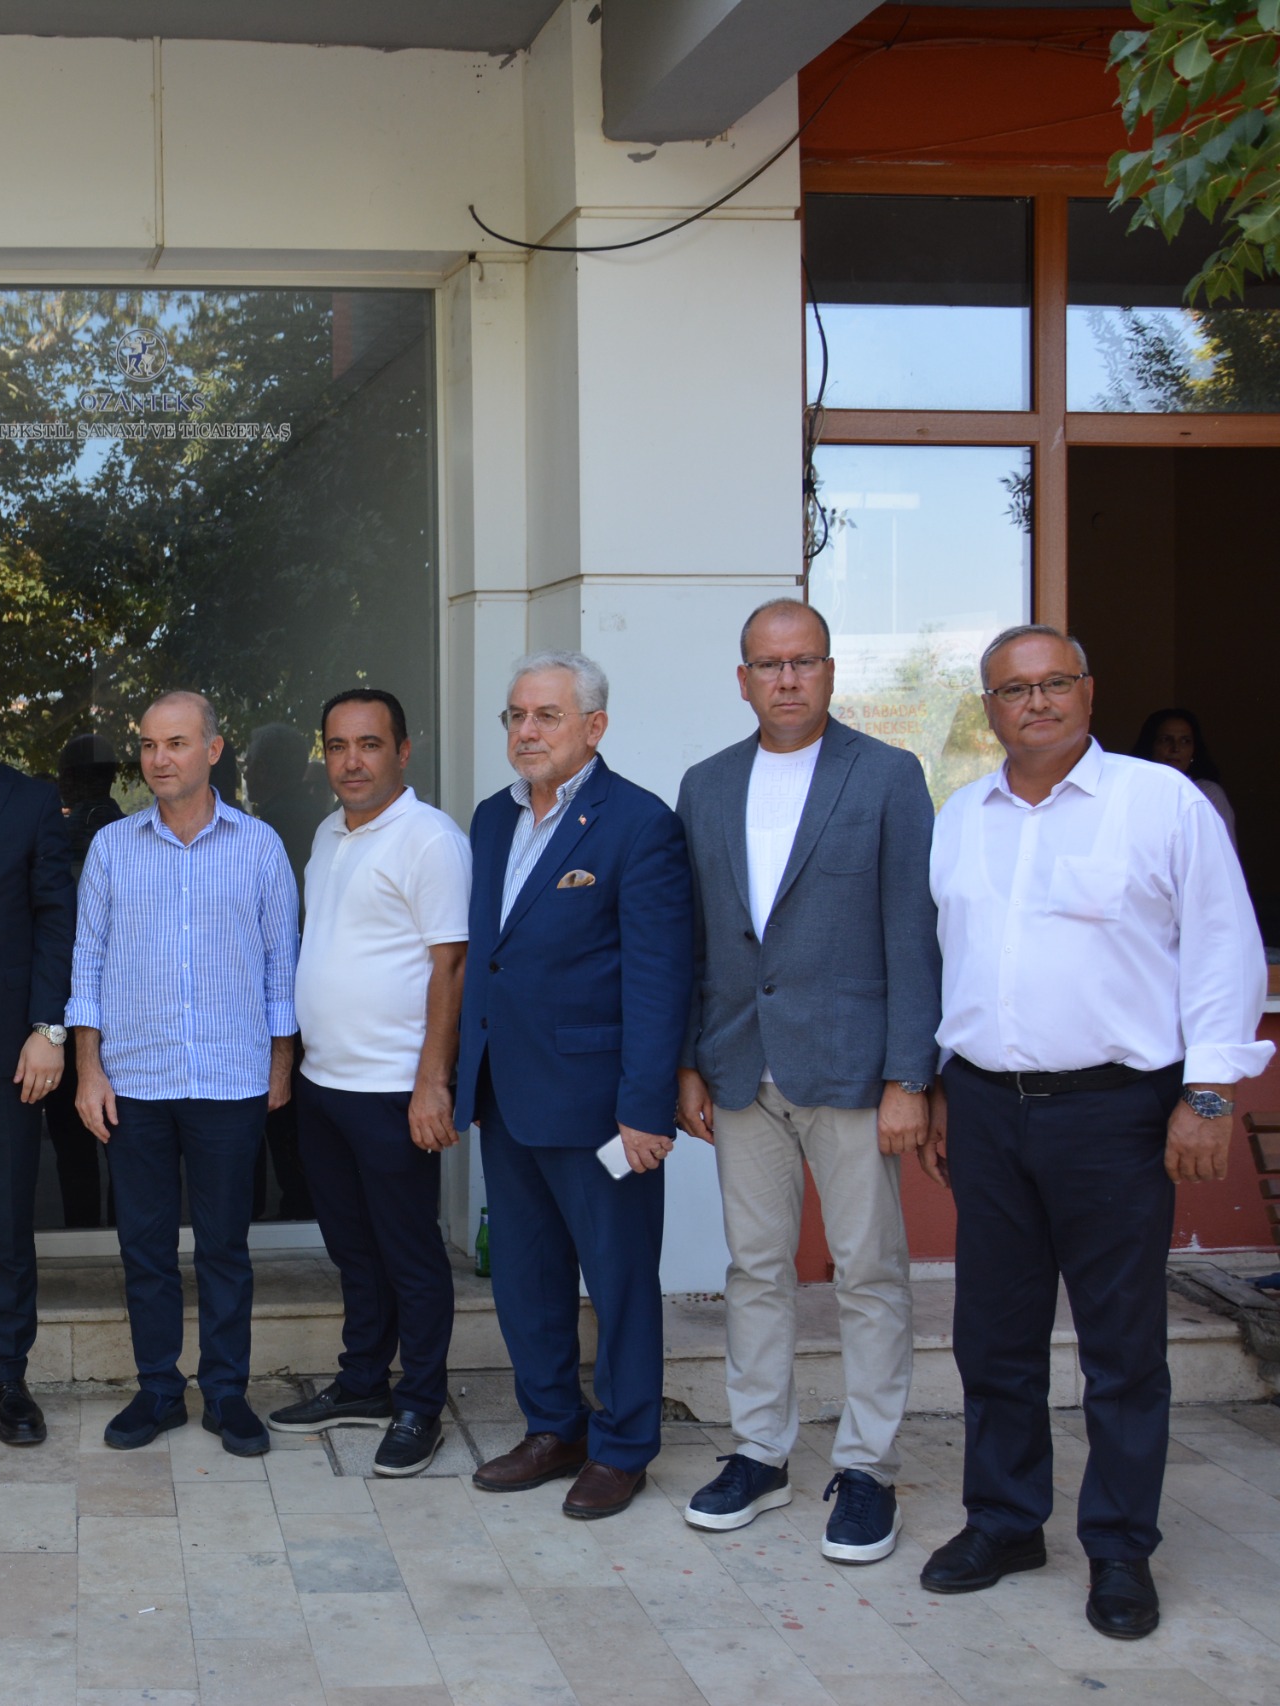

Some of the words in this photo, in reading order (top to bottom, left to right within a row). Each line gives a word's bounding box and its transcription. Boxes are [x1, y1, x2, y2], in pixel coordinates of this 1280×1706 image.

[80, 392, 206, 412] OZANTEKS
[77, 420, 149, 439] SANAYİ
[150, 422, 176, 439] VE
[179, 420, 259, 439] TİCARET
[863, 699, 928, 718] BABADAĞ
